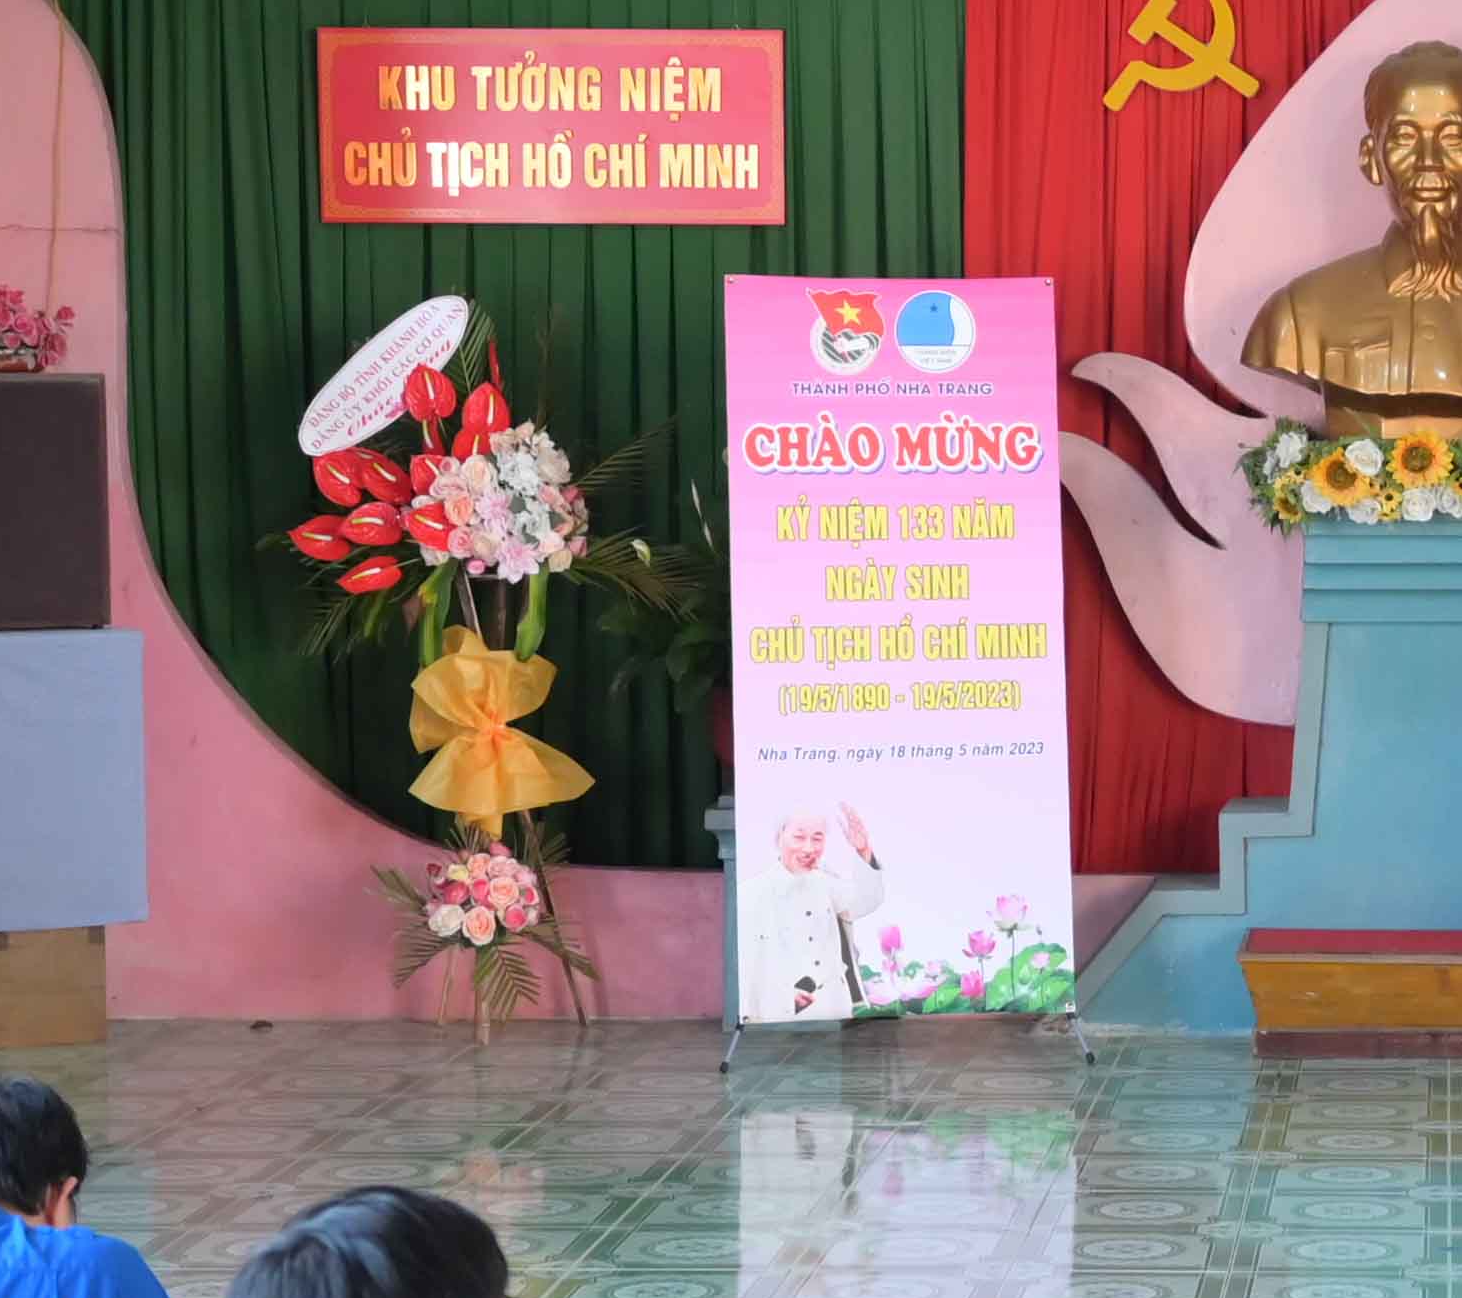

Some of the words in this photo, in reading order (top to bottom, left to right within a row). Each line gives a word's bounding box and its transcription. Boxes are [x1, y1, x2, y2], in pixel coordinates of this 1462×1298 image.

[379, 65, 457, 112] KHU
[472, 50, 602, 112] TƯỞNG
[620, 56, 721, 122] NIỆM
[344, 127, 417, 187] CHỦ
[427, 141, 509, 197] TỊCH
[523, 129, 575, 187] HỒ
[584, 134, 649, 187] CHÍ
[660, 142, 759, 188] MINH
[896, 383, 931, 394] NHA
[939, 383, 993, 395] TRANG
[743, 412, 883, 469] CHÀO
[893, 412, 1041, 469] MỪNG
[777, 494, 811, 541] KỶ
[819, 497, 889, 549] NIỆM
[897, 505, 945, 540] 133
[952, 497, 1015, 540] NĂM
[825, 558, 897, 601] NGÀY
[906, 563, 970, 600] SINH
[750, 615, 804, 663] CHỦ
[812, 626, 871, 670] TỊCH
[880, 614, 915, 661] HỒ
[924, 617, 969, 660] CHÍ
[976, 622, 1048, 659] MINH
[779, 683, 890, 715] (19/5/1890
[912, 681, 1021, 710] 19/5/2023)
[758, 748, 787, 761] Nha
[890, 745, 905, 759] 18
[959, 744, 967, 757] 5
[1010, 742, 1044, 756] 2023
